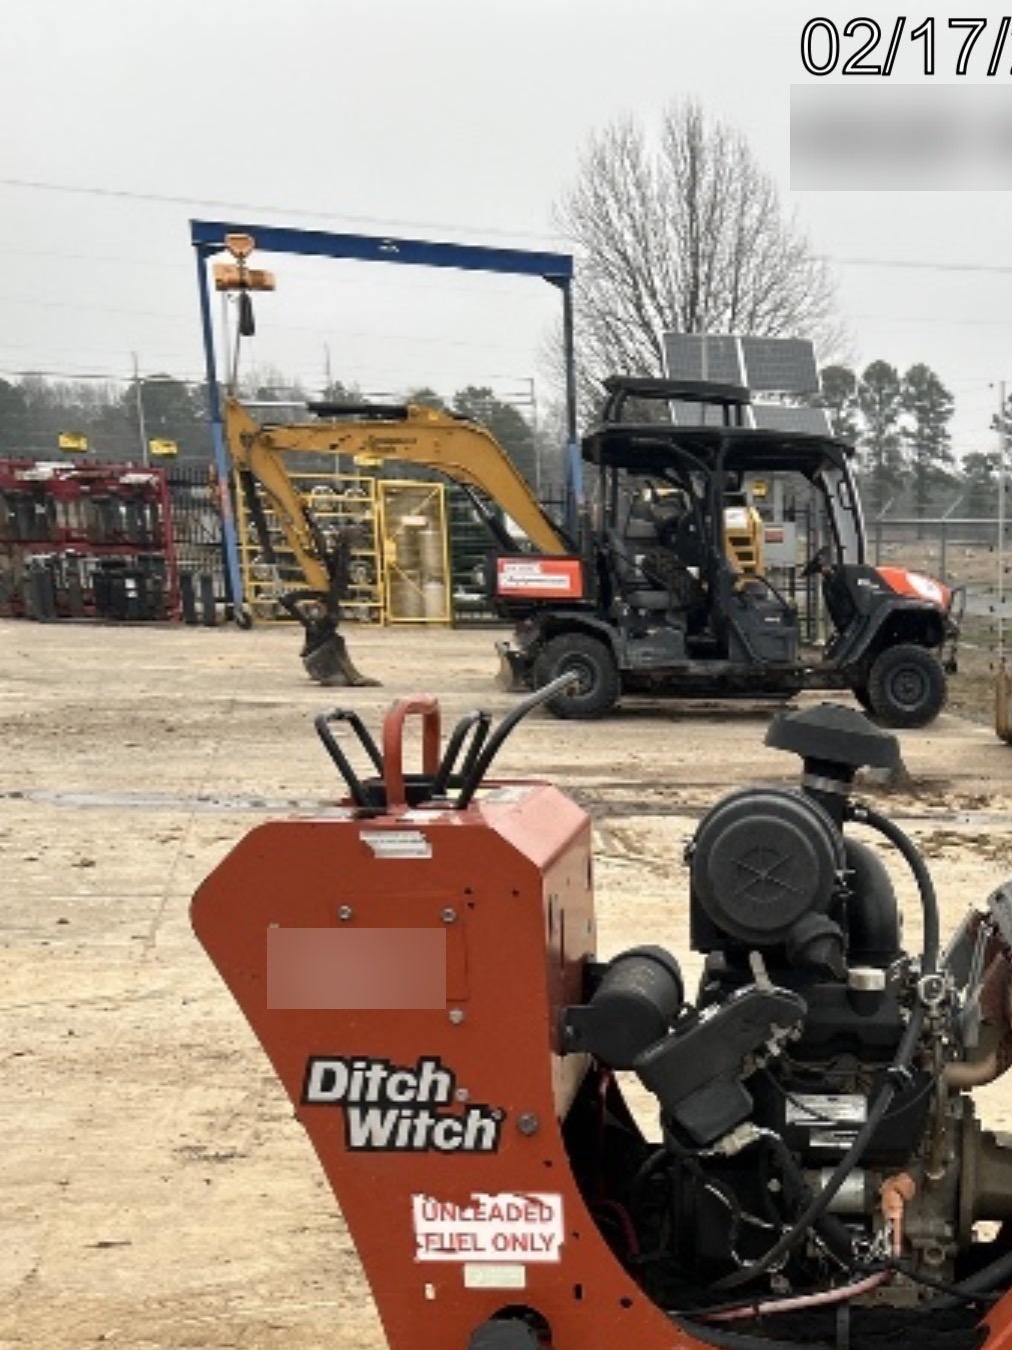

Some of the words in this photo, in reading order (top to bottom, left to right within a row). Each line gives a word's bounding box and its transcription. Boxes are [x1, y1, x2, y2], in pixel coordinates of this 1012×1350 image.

[307, 1060, 452, 1102] Ditch
[348, 1107, 497, 1150] Witch
[421, 1202, 555, 1224] UNLEADED
[424, 1232, 487, 1253] FUEL
[491, 1232, 556, 1252] ONLY
